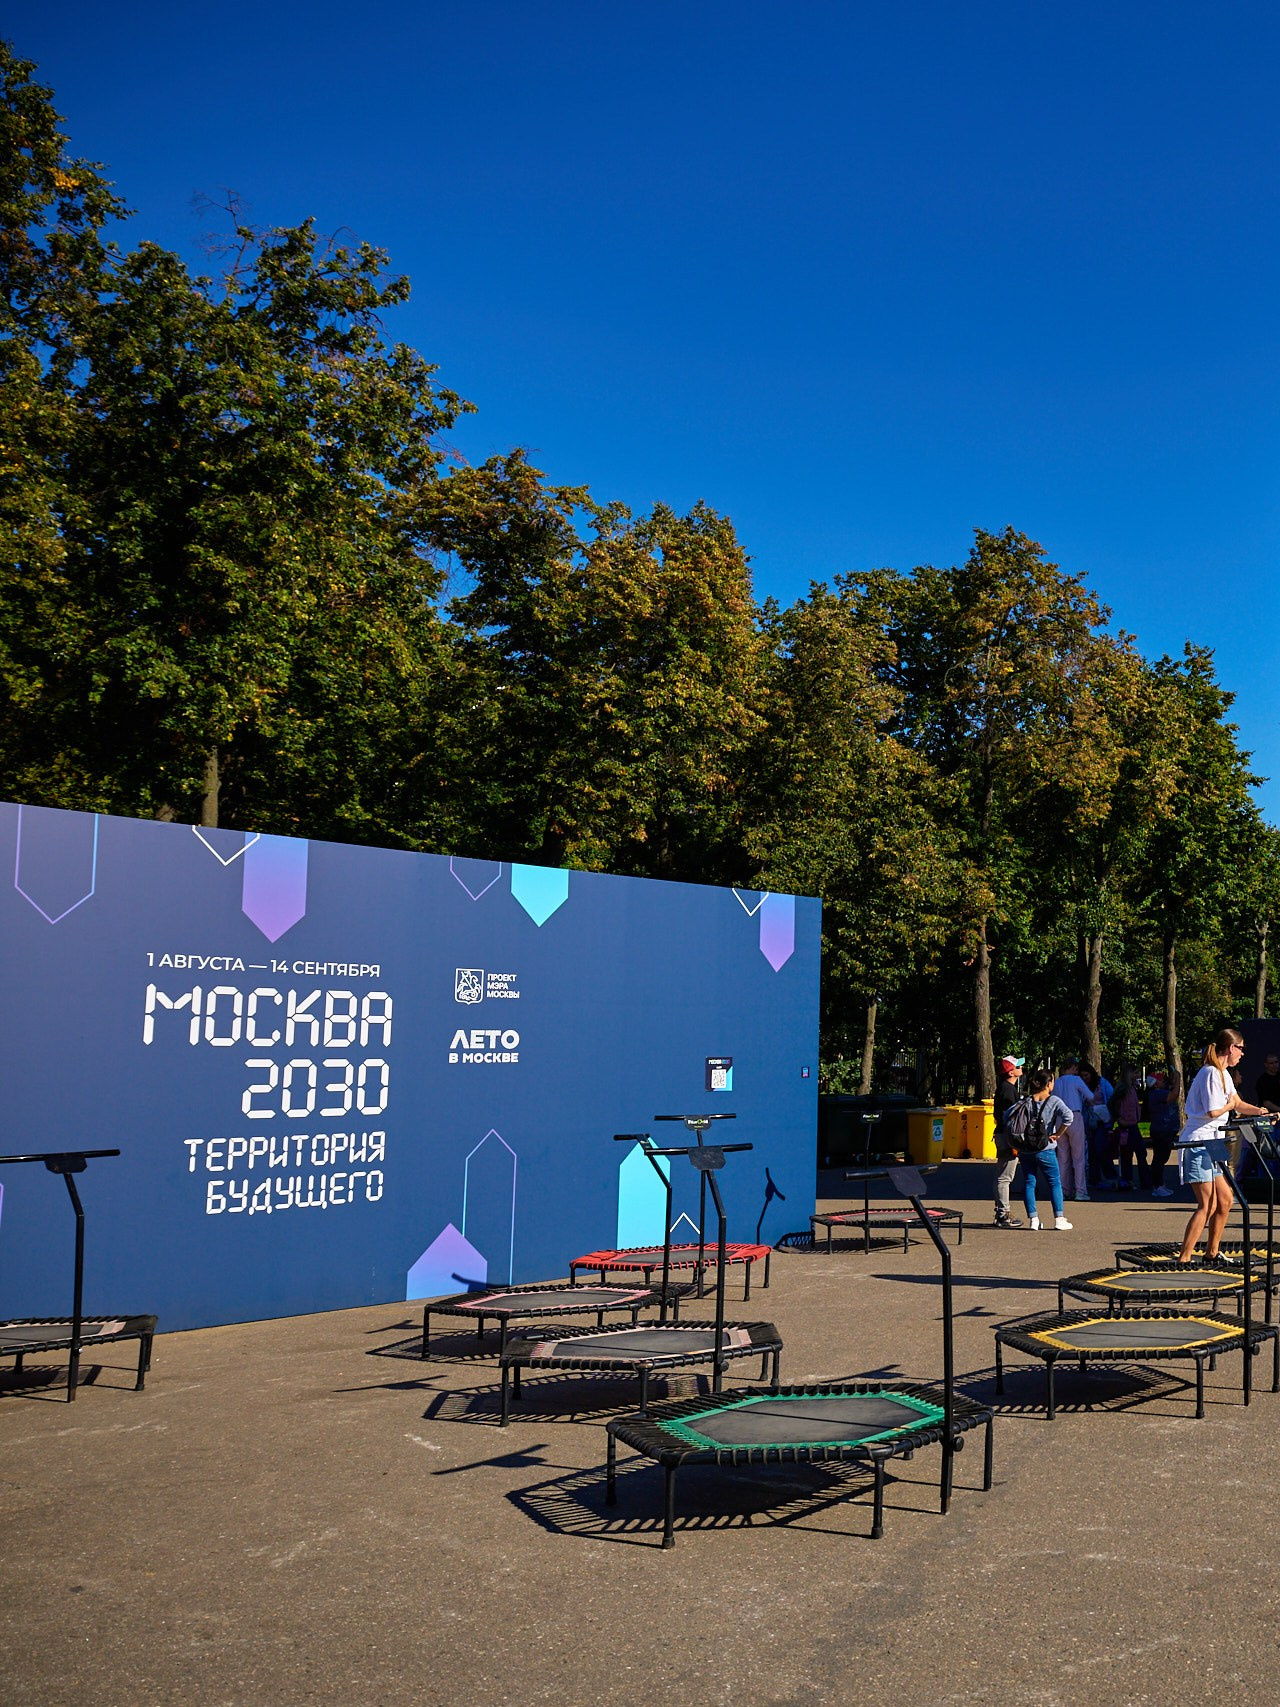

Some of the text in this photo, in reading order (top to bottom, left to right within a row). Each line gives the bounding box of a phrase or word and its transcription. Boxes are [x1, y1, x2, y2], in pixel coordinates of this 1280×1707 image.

[146, 953, 154, 967] 1
[159, 953, 245, 972] АВГУСТА
[271, 959, 289, 974] 14
[292, 960, 381, 978] СЕНТЯБРЯ
[487, 973, 517, 982] ПРОЕКТ
[487, 982, 509, 990] МЭРА
[486, 990, 520, 999] МОСКВЫ
[143, 983, 393, 1048] МОСКВА
[449, 1029, 520, 1050] ЛЕТО
[448, 1052, 519, 1064] В МОСКВЕ
[241, 1058, 390, 1119] 2030
[183, 1131, 386, 1172] ТЕРРИТОРИЯ
[205, 1170, 385, 1215] БУДУЩЕГО
